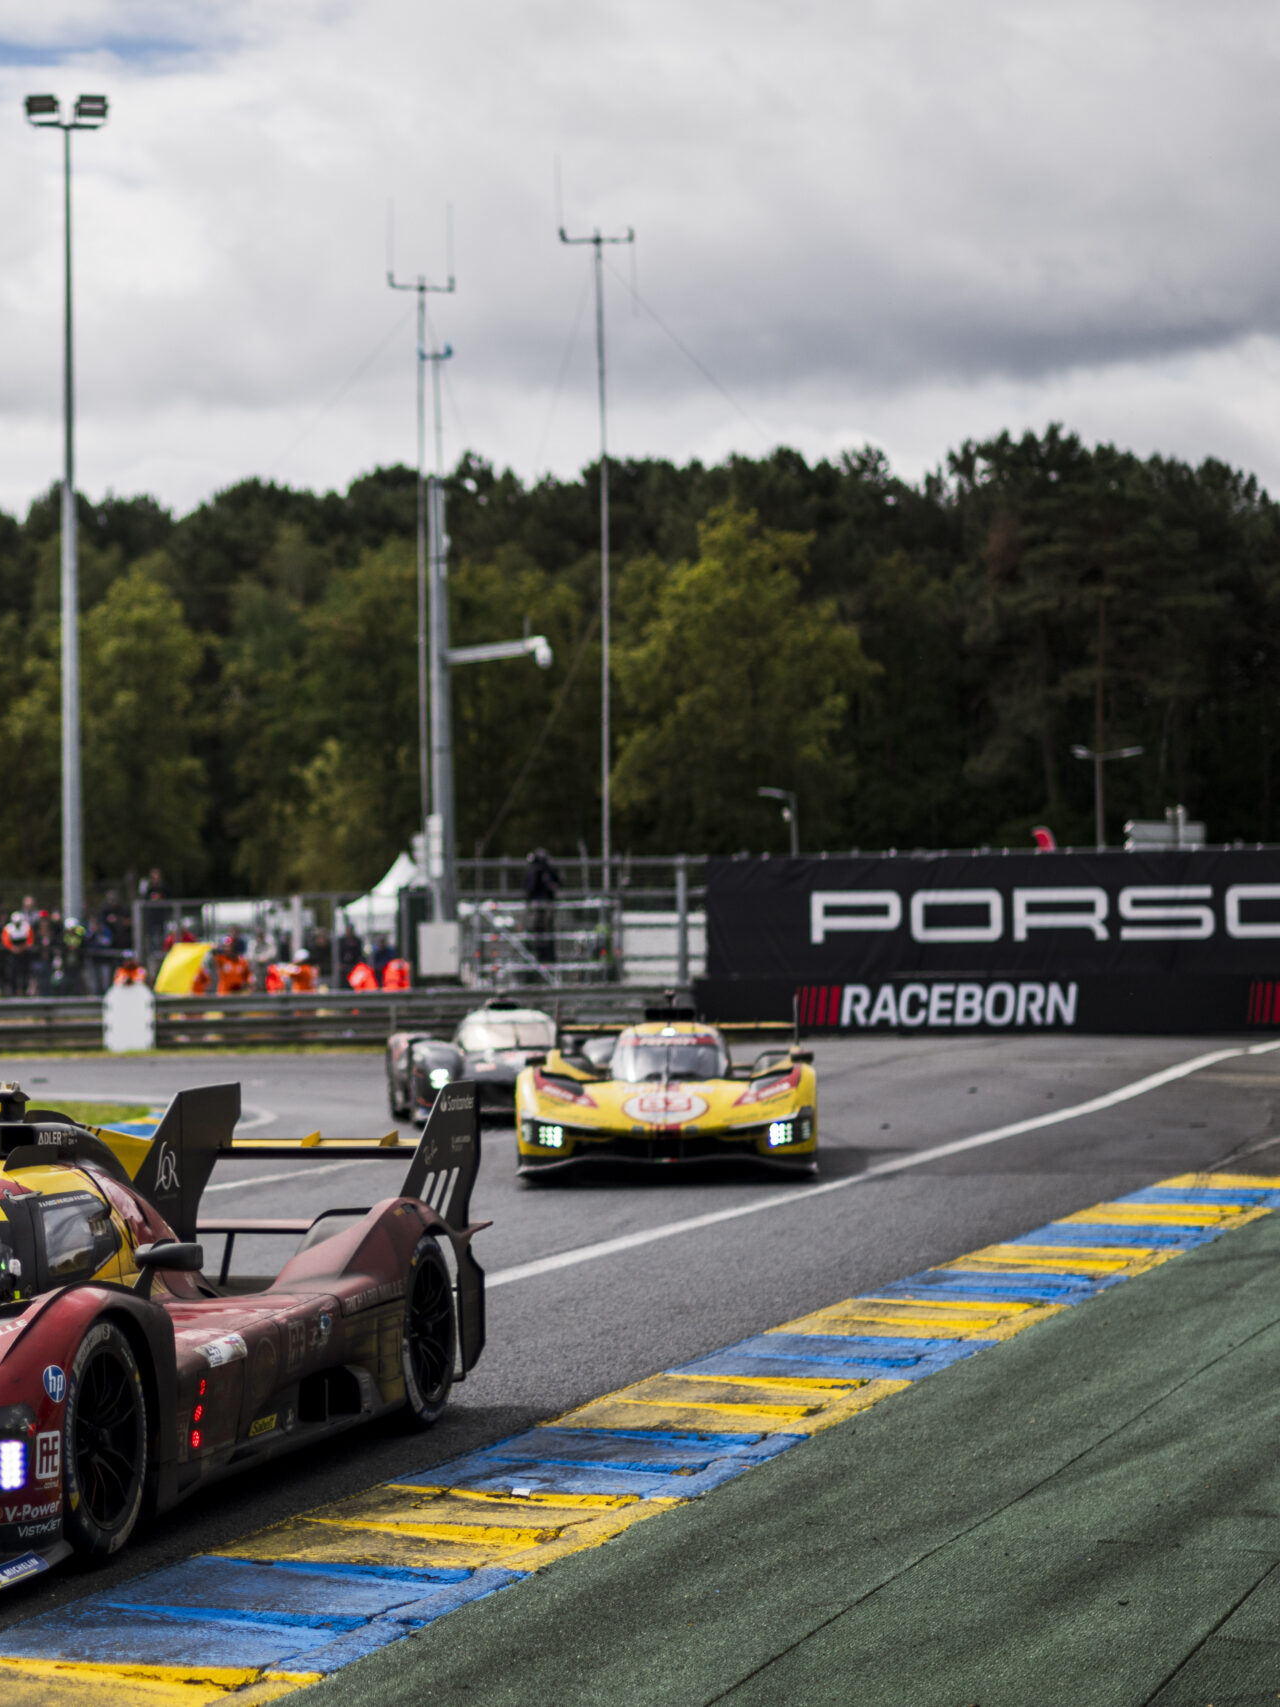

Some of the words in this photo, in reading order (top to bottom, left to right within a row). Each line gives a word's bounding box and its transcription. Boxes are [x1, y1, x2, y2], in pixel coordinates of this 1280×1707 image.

[810, 884, 1280, 944] PORSC
[840, 982, 1078, 1027] RACEBORN
[37, 1131, 62, 1146] ADLER
[47, 1367, 64, 1401] hp
[5, 1501, 61, 1522] V-Power
[17, 1518, 62, 1537] VISTAJET
[2, 1557, 40, 1577] MICHELIN
